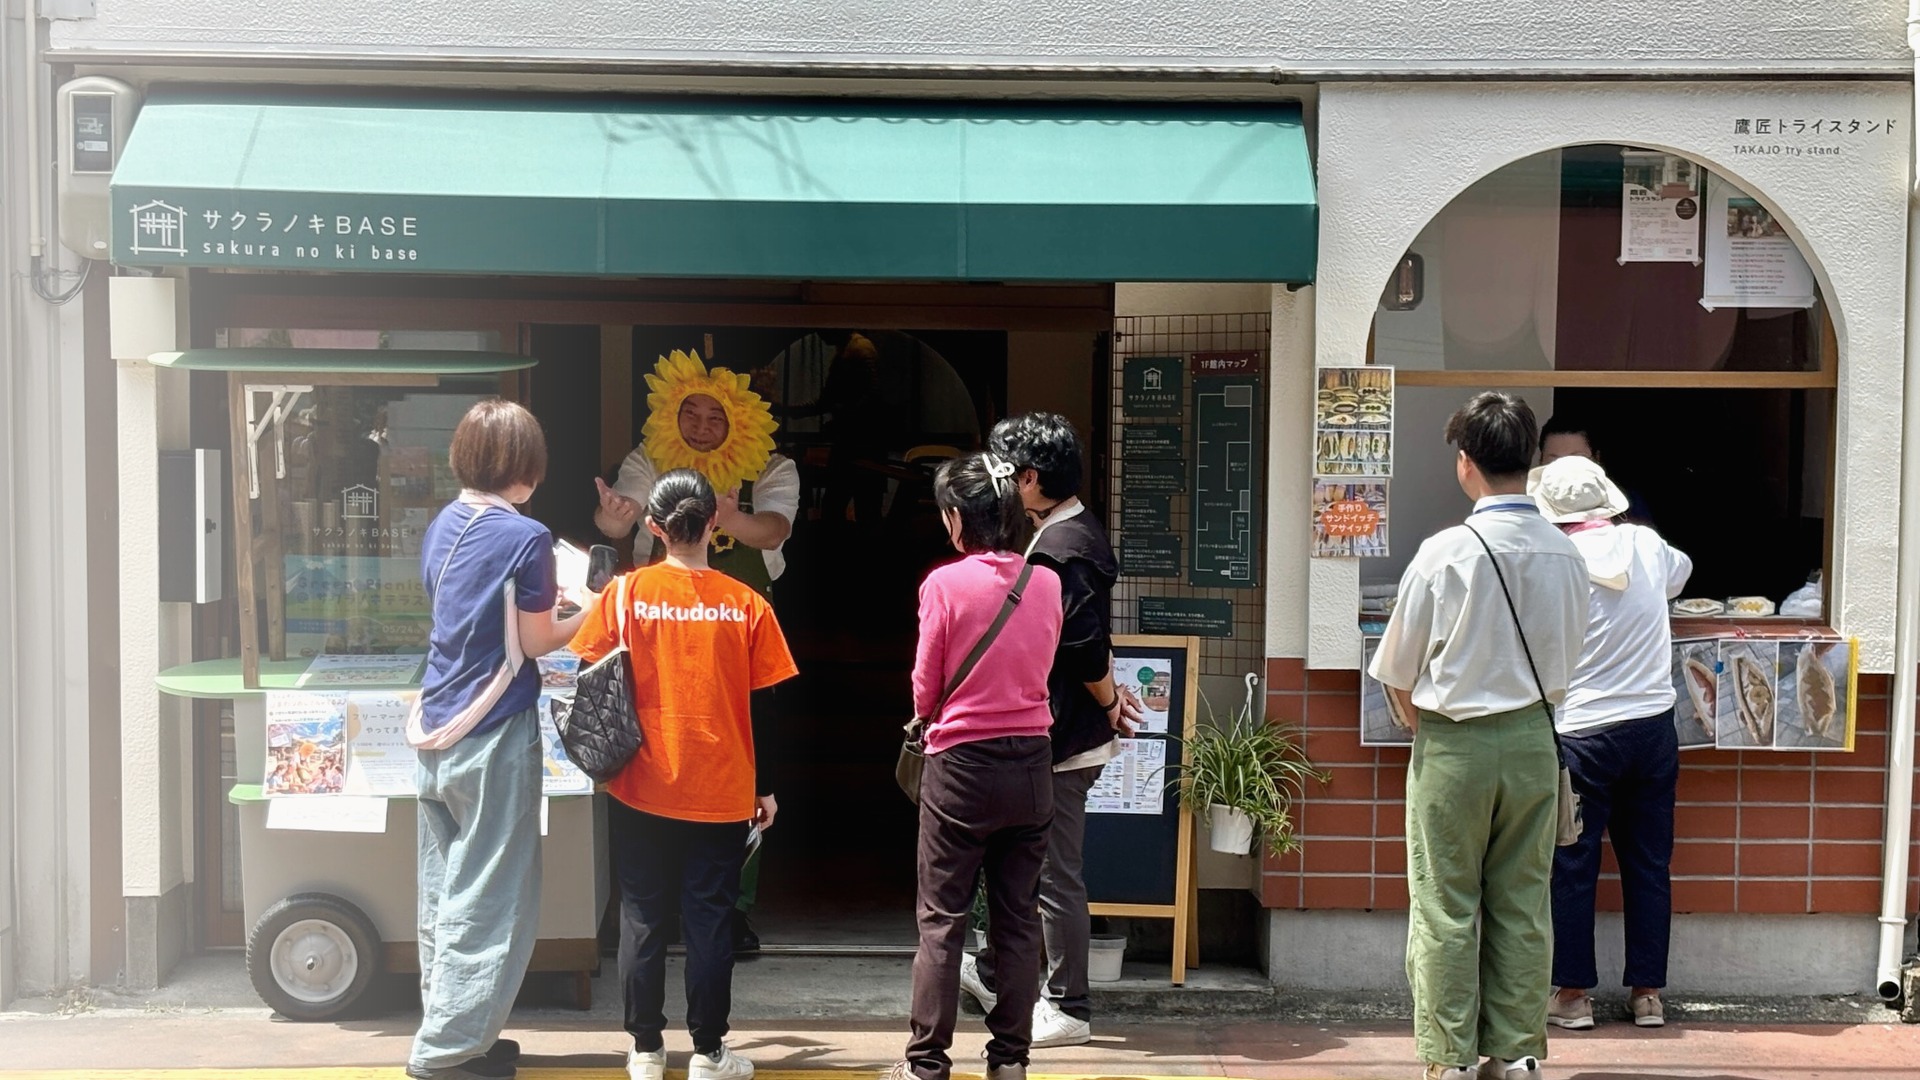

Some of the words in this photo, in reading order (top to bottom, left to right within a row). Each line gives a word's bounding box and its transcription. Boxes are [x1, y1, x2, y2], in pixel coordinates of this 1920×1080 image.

[1734, 118, 1897, 135] 鷹匠トライスタンド
[1734, 145, 1780, 155] TAKAJO
[1785, 145, 1802, 157] try
[1807, 145, 1840, 155] stand
[202, 209, 418, 237] サクラノキBASE
[202, 239, 280, 257] sakura
[296, 243, 320, 259] no
[335, 242, 356, 260] ki
[371, 243, 418, 261] base
[1200, 358, 1249, 370] 1F館内マップ
[1338, 504, 1361, 512] 手作り
[1326, 514, 1375, 522] サンドイッチ
[312, 526, 408, 538] サクラノキBASE
[1331, 524, 1369, 532] アサイッチ
[634, 601, 745, 621] Rakudoku
[376, 699, 401, 708] こども
